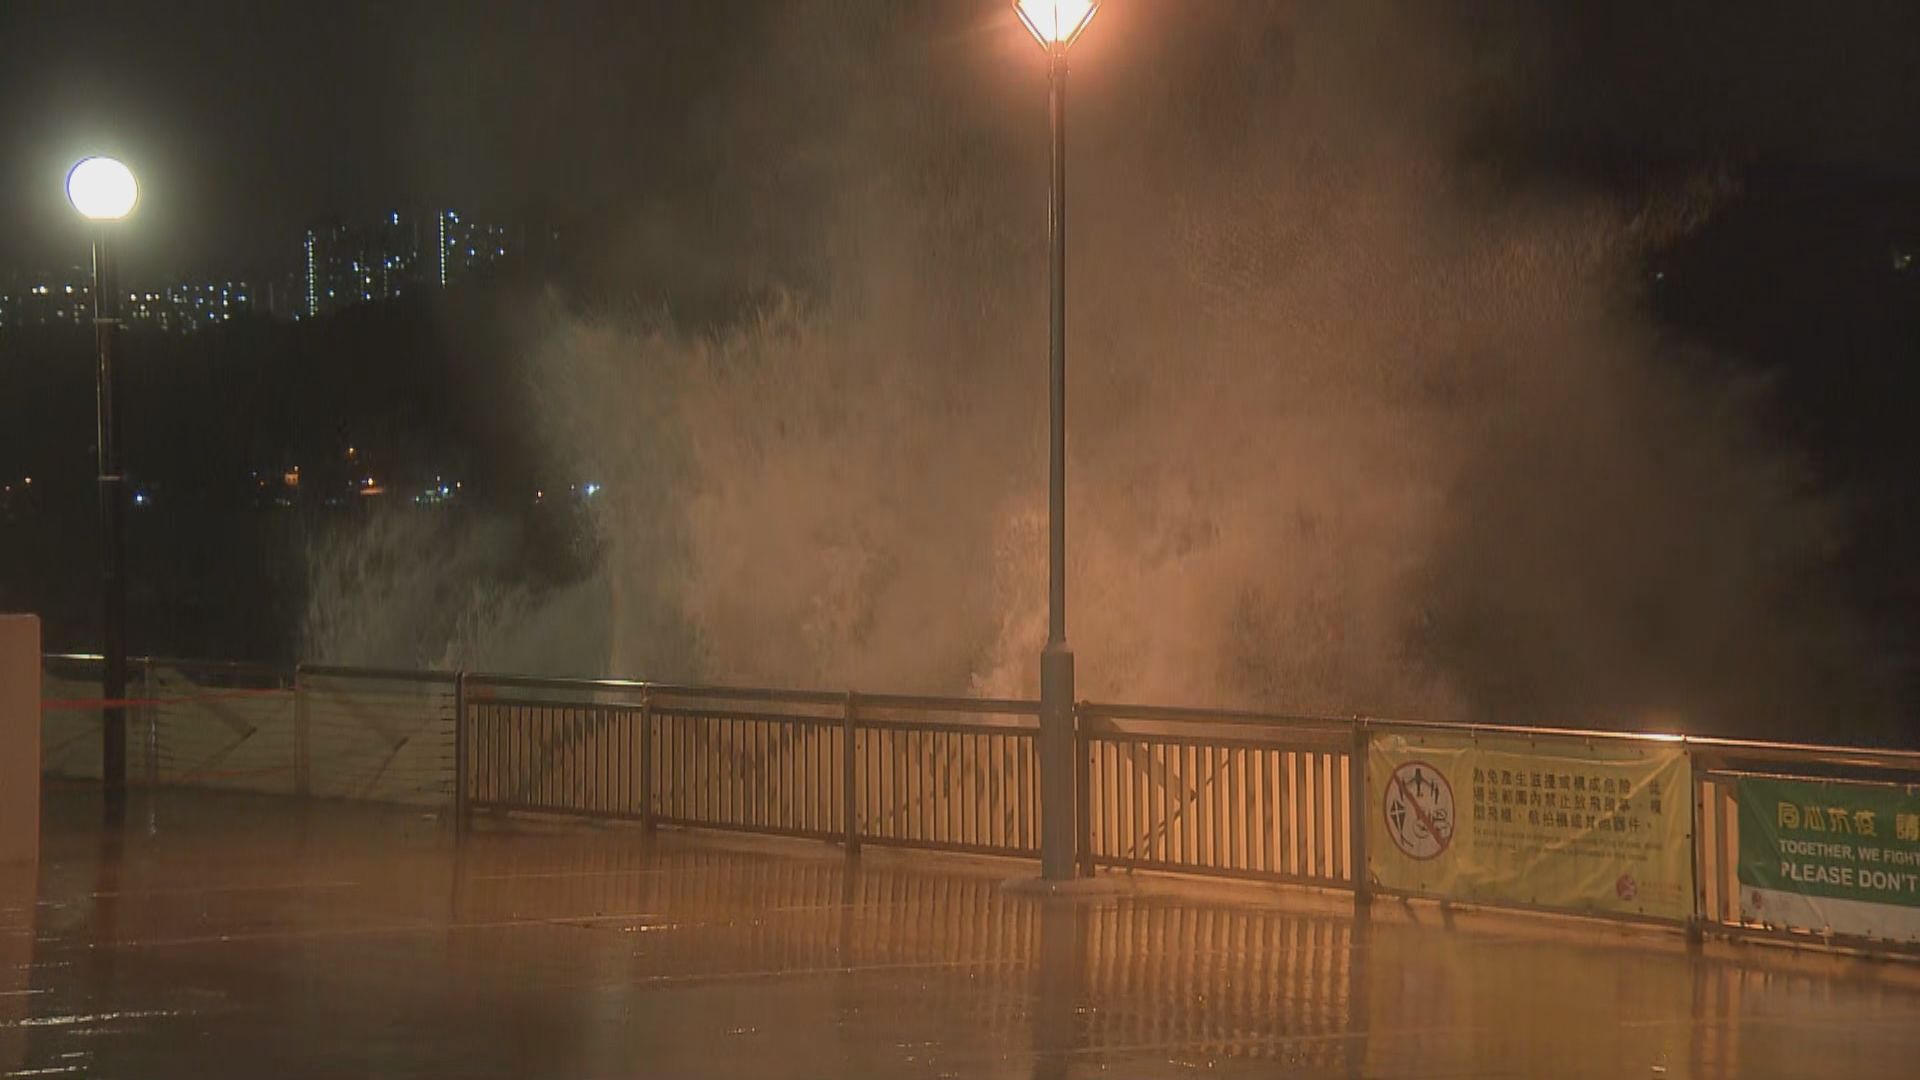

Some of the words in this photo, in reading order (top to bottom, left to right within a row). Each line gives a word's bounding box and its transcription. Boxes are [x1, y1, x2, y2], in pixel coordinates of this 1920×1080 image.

[1780, 839, 1855, 861] TOGETHER,
[1857, 847, 1880, 861] WE
[1781, 862, 1853, 887] PLEASE
[1859, 870, 1917, 892] DON'T
